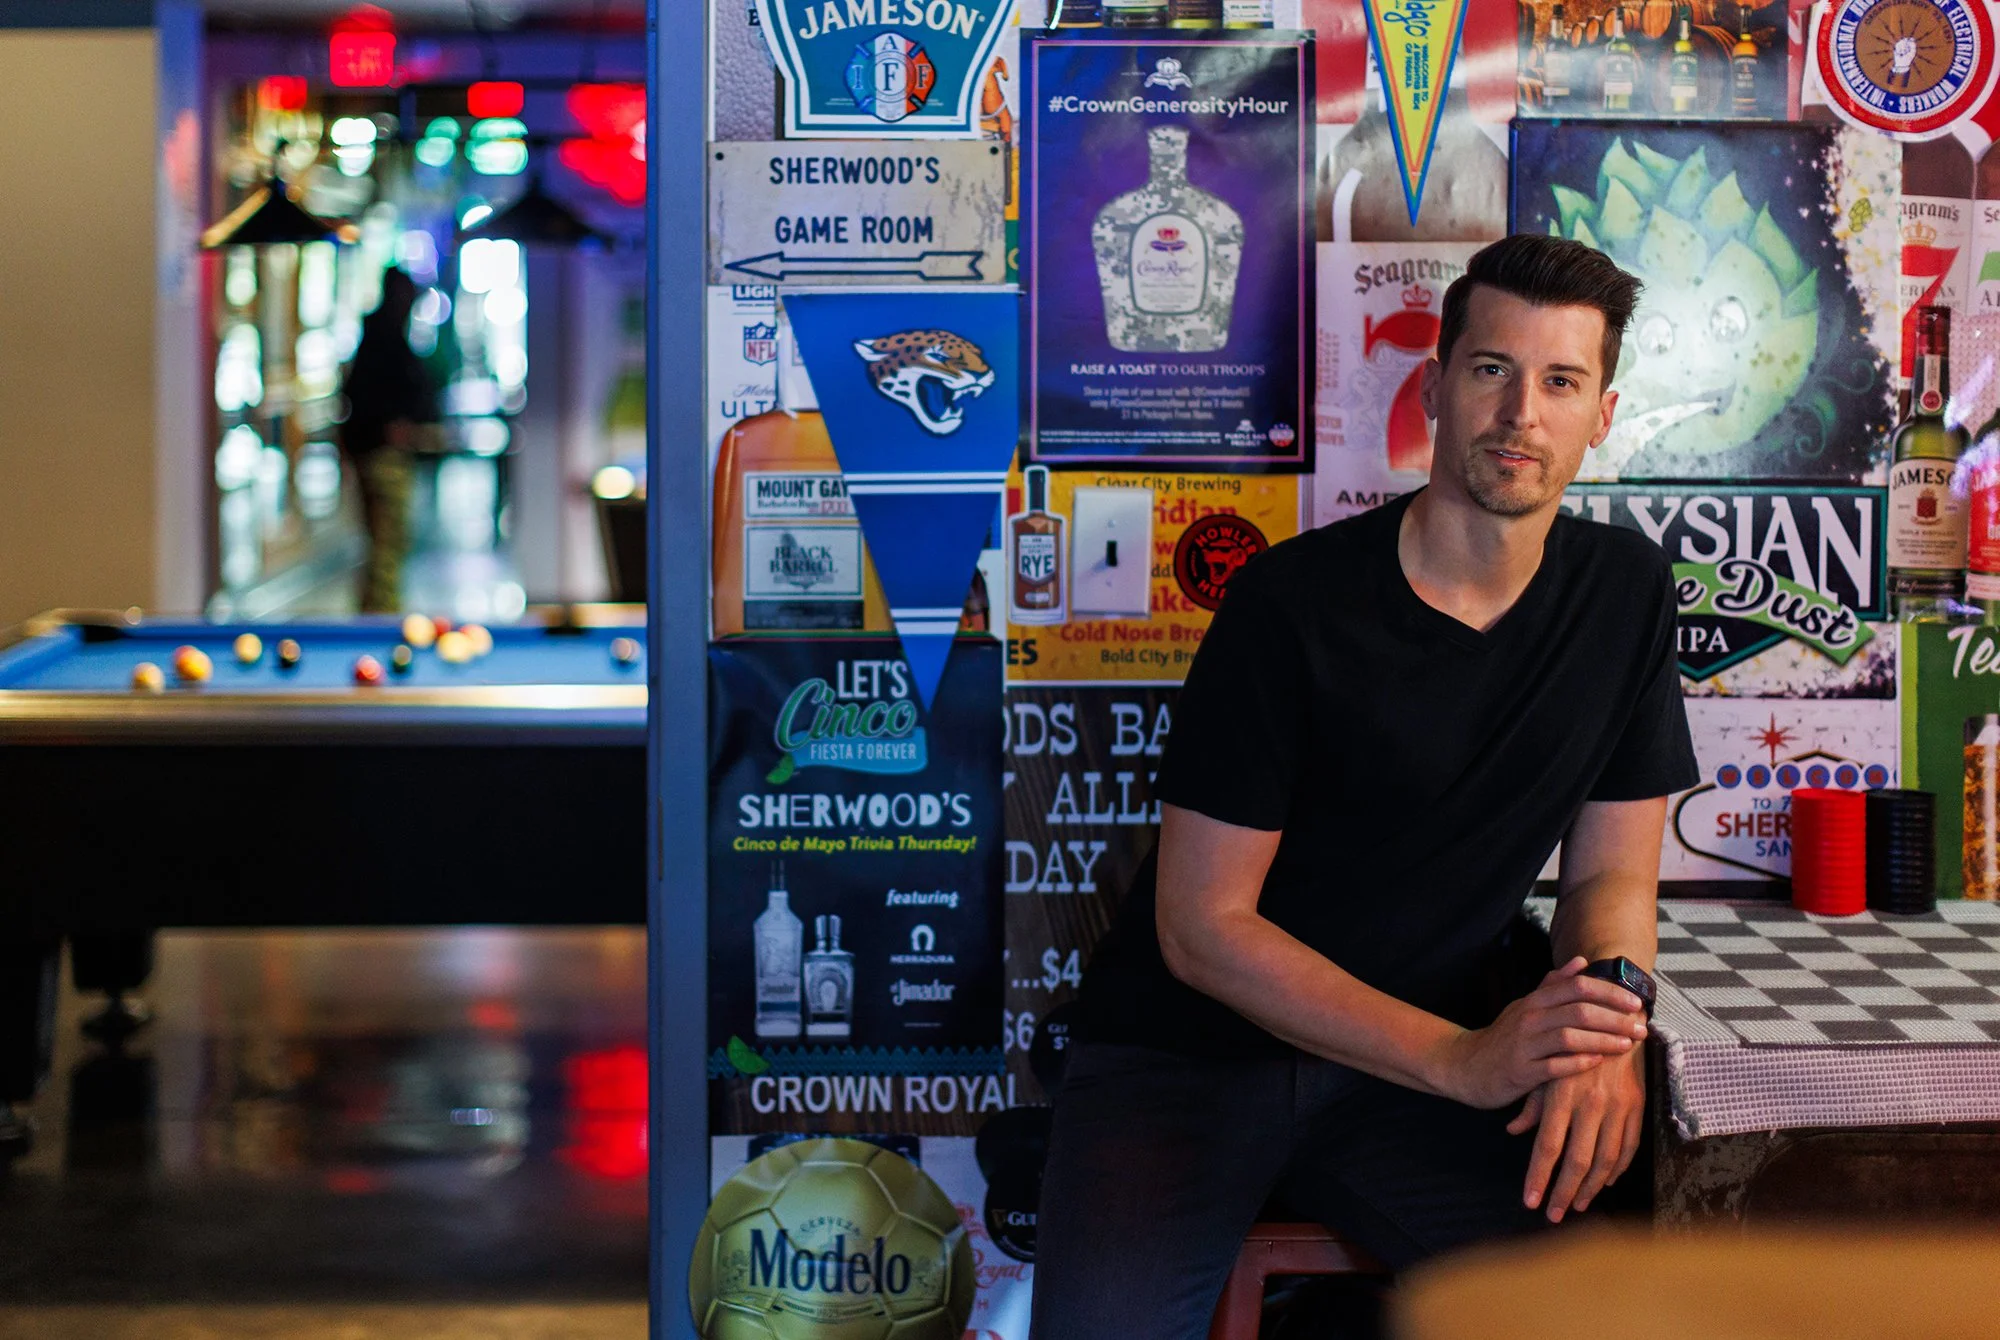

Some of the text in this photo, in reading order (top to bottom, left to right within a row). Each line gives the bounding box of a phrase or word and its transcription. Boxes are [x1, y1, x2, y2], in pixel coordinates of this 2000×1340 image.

[799, 0, 979, 39] JAMESON
[1946, 6, 1974, 80] ELECTRICAL
[1837, 18, 1887, 110] INTERNATIONAL
[1047, 95, 1289, 118] #CrownGenerosityHour
[1899, 78, 1957, 114] WORKERS
[769, 156, 940, 185] SHERWOOD'S
[775, 215, 934, 244] GAME ROOM
[746, 341, 776, 361] NFL
[1071, 363, 1266, 377] RAISE A TOAST TO OUR TROOPS
[757, 479, 816, 498] MOUNT
[1142, 476, 1172, 492] City
[1176, 476, 1242, 495] Brewing
[775, 545, 833, 559] BLACK
[1562, 495, 1873, 608] YSIAN
[1021, 554, 1054, 578] RYE
[1712, 558, 1857, 649] Dust
[1060, 622, 1102, 643] Cold
[1111, 623, 1164, 643] Nose
[1676, 626, 1731, 653] IPA
[1100, 648, 1135, 664] Bold
[1138, 648, 1170, 667] City
[837, 660, 908, 699] LET'S
[774, 677, 917, 752] Cinco
[810, 743, 917, 760] FIESTA FOREVER
[739, 792, 972, 828] SHERWOOD'S
[1752, 797, 1773, 811] TO
[733, 834, 977, 854] Cinco de Mayo Trivia Thursday!
[885, 888, 959, 909] featuring
[751, 1075, 892, 1114] CROWN
[749, 1229, 911, 1295] Modelo
